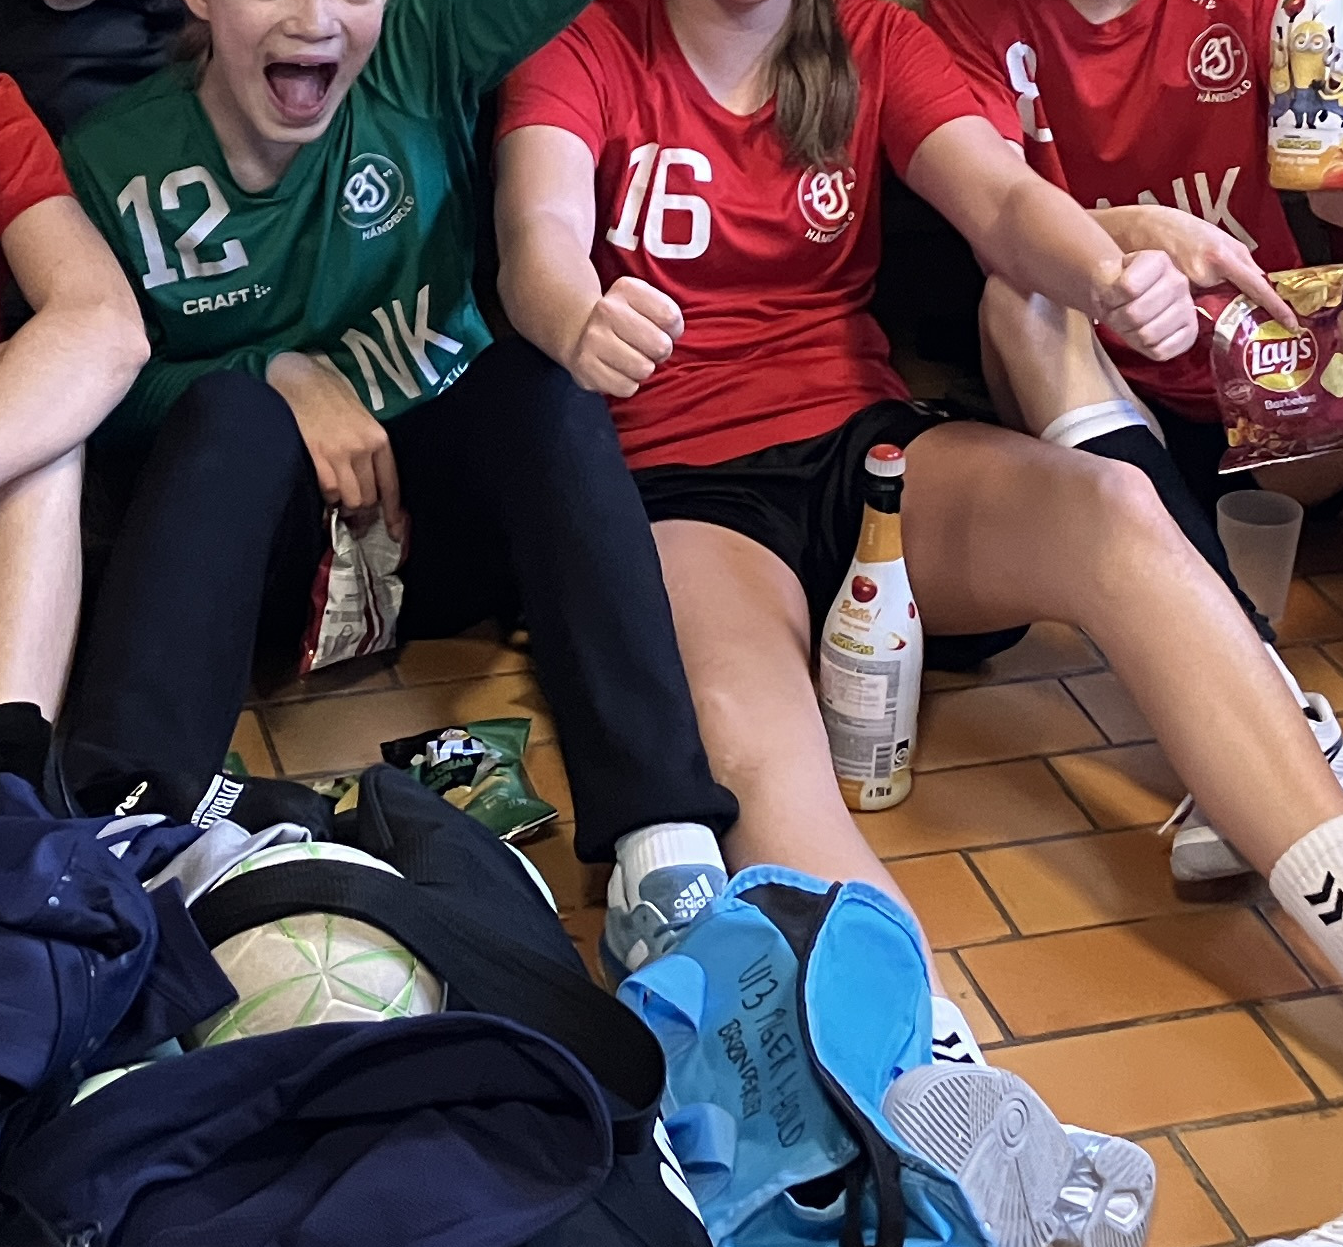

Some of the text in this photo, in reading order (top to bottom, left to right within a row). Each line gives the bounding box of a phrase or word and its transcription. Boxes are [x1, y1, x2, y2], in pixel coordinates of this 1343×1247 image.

[116, 165, 250, 290] 12
[606, 143, 712, 260] 16
[182, 288, 250, 315] CRAFT
[673, 896, 712, 910] adid
